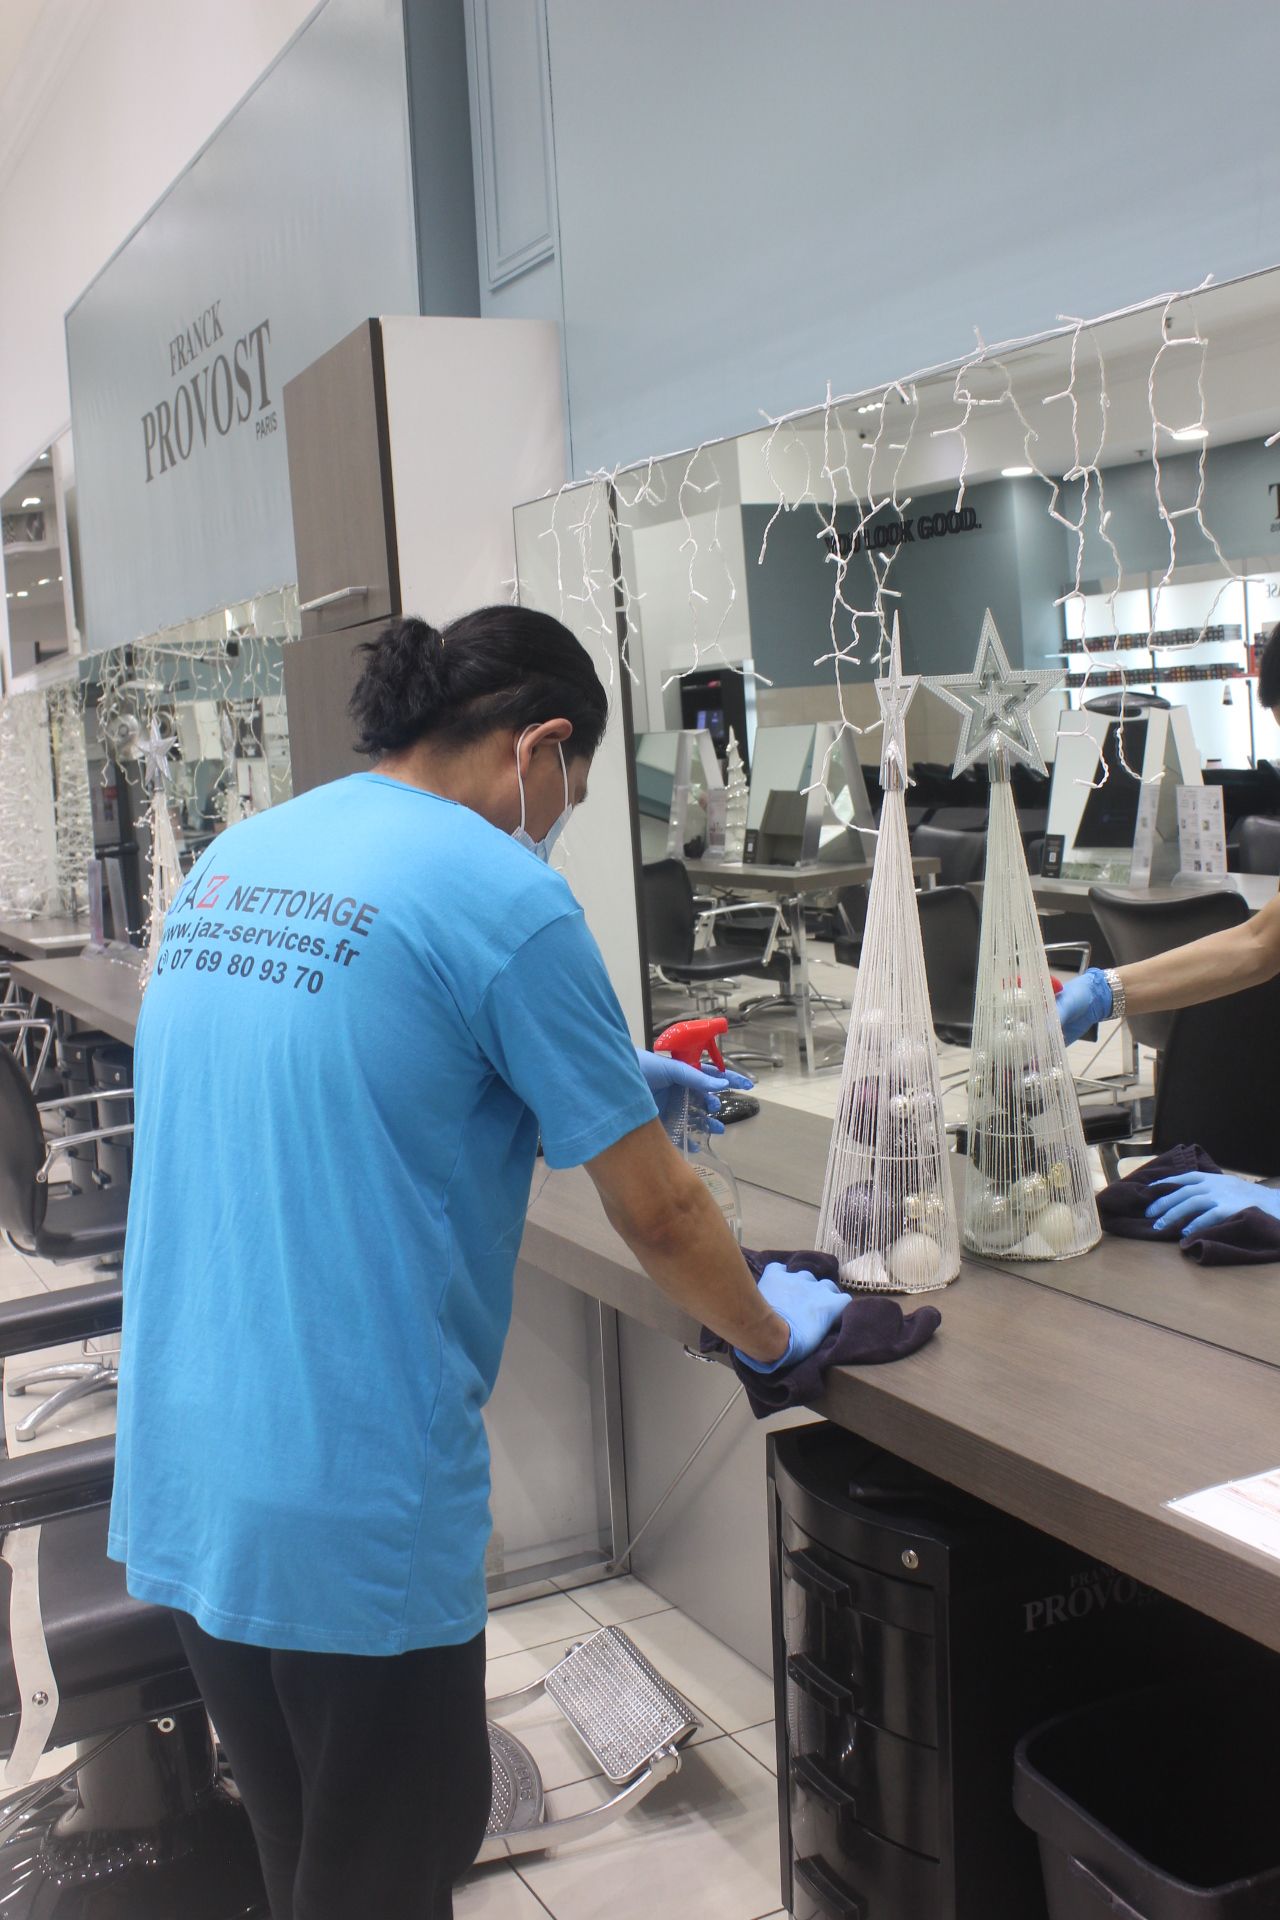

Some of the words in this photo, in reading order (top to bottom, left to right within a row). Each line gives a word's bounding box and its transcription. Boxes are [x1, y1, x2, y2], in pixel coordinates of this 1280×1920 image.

[169, 299, 224, 377] FRANCK
[141, 318, 272, 483] PROVOST
[255, 411, 278, 440] PARIS
[864, 519, 915, 550] LOOK
[917, 507, 982, 540] GOOD.
[226, 885, 380, 937] NETTOYAGE
[171, 949, 193, 970] 07
[195, 949, 222, 972] 69
[227, 954, 255, 978] 80
[258, 959, 288, 984] 93
[293, 966, 324, 994] 70
